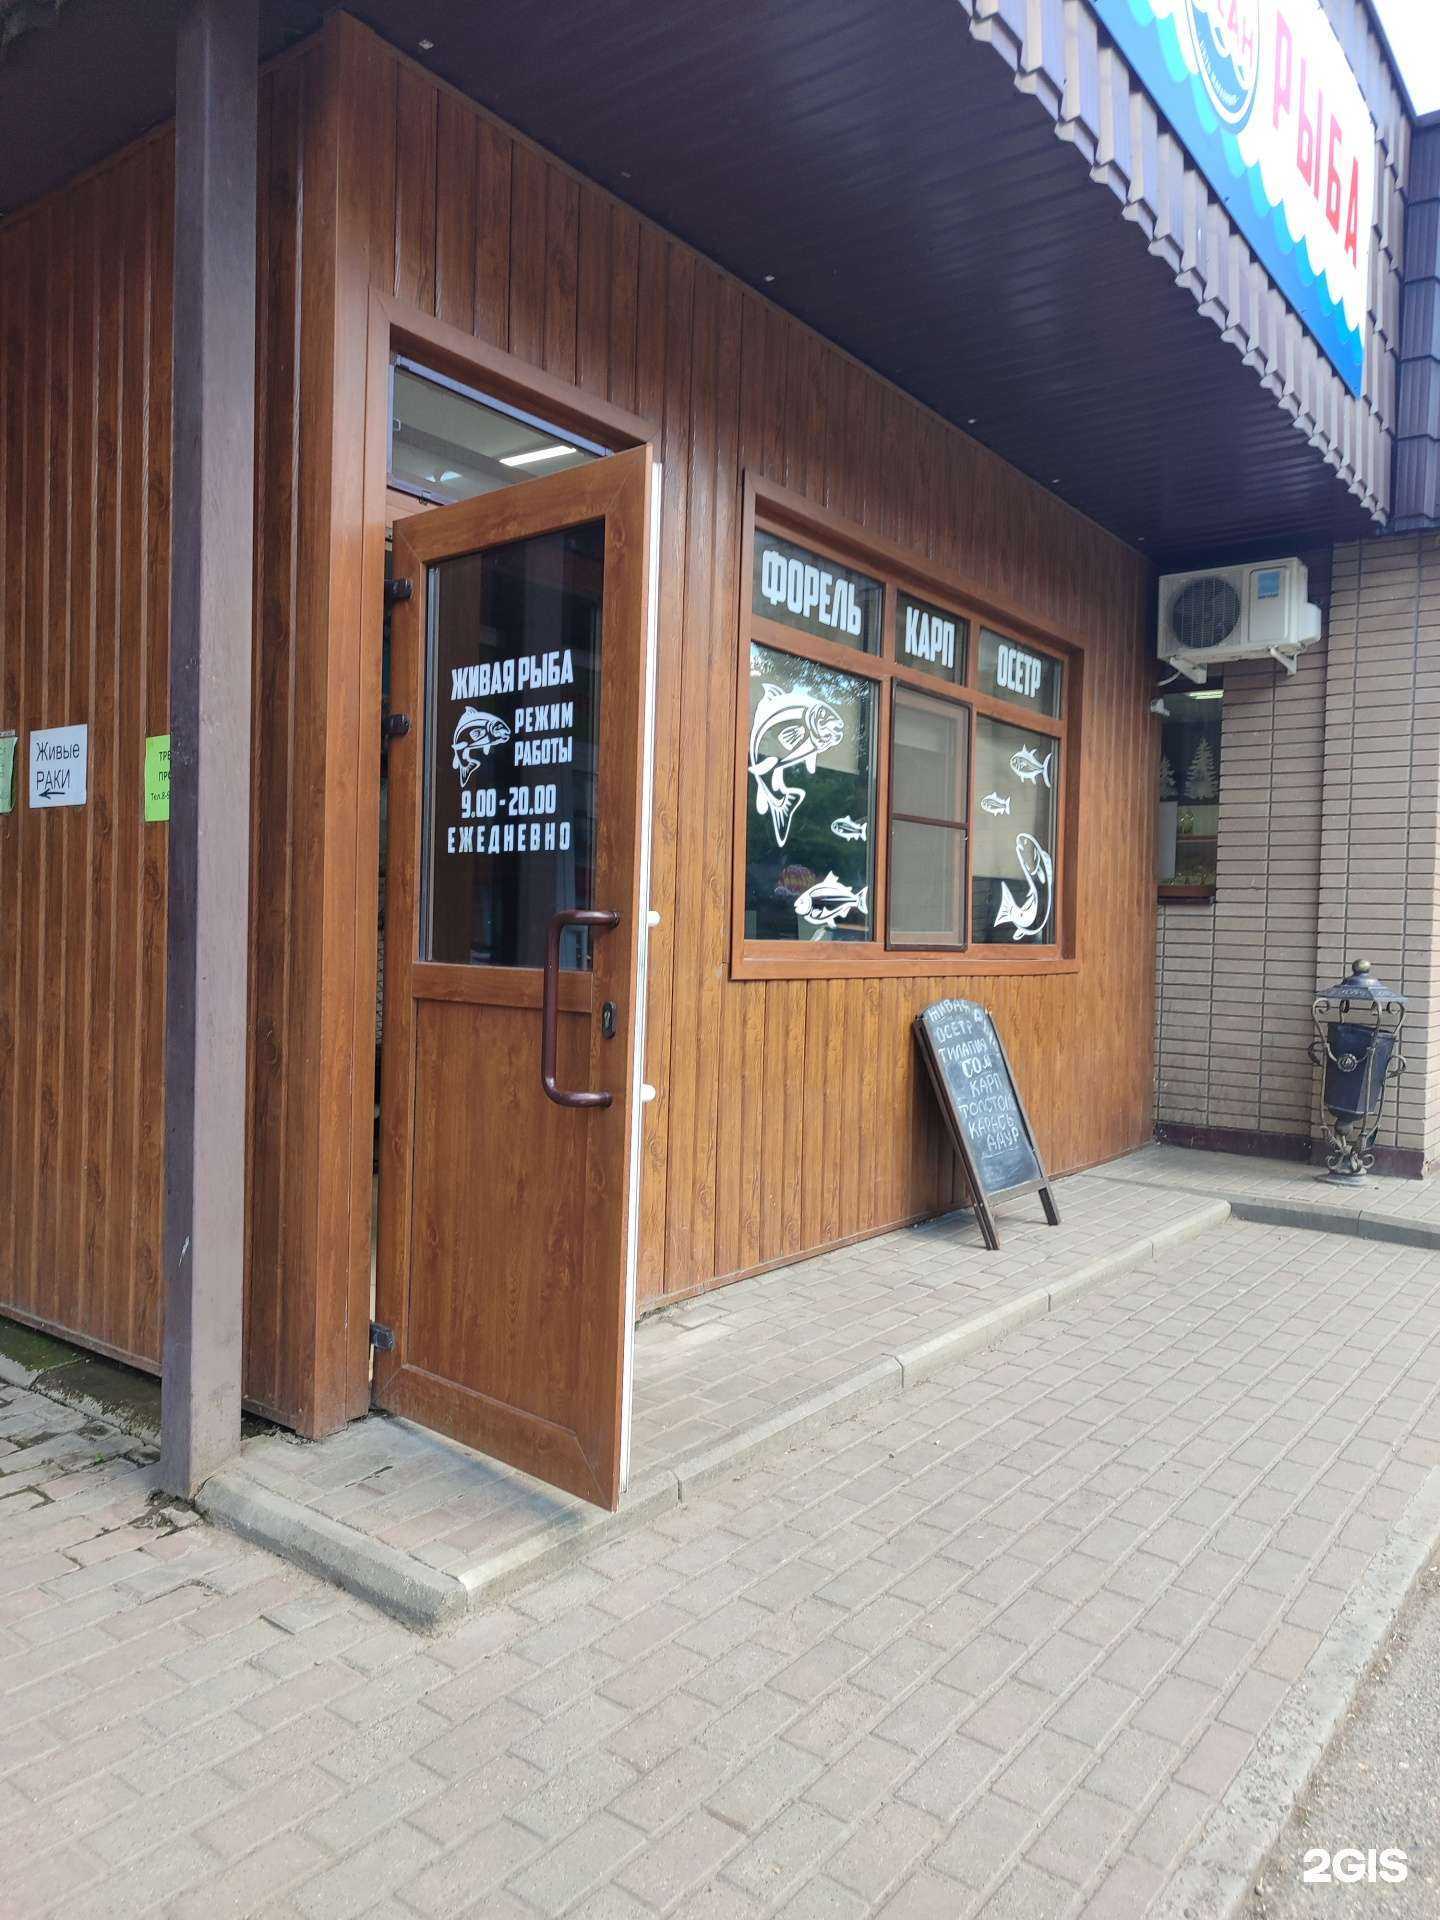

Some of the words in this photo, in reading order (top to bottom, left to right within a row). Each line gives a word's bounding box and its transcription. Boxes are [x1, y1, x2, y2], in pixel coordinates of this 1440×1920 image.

[1273, 9, 1359, 268] РЫБА
[761, 550, 862, 636] ФОРЕЛЬ
[905, 606, 955, 668] КАРП
[451, 659, 515, 701] ЖИВАЯ
[517, 649, 574, 691] РЫБА
[996, 644, 1042, 698] ОСЕТР
[514, 701, 574, 734] РЕЖИМ
[36, 742, 80, 762] Живые
[514, 736, 573, 767] РАБОТЫ
[36, 769, 71, 790] РАКИ
[447, 822, 571, 854] ЕЖЕДНЕВНО
[936, 1020, 973, 1043] ОСЕТР
[969, 1072, 1002, 1098] КАРП
